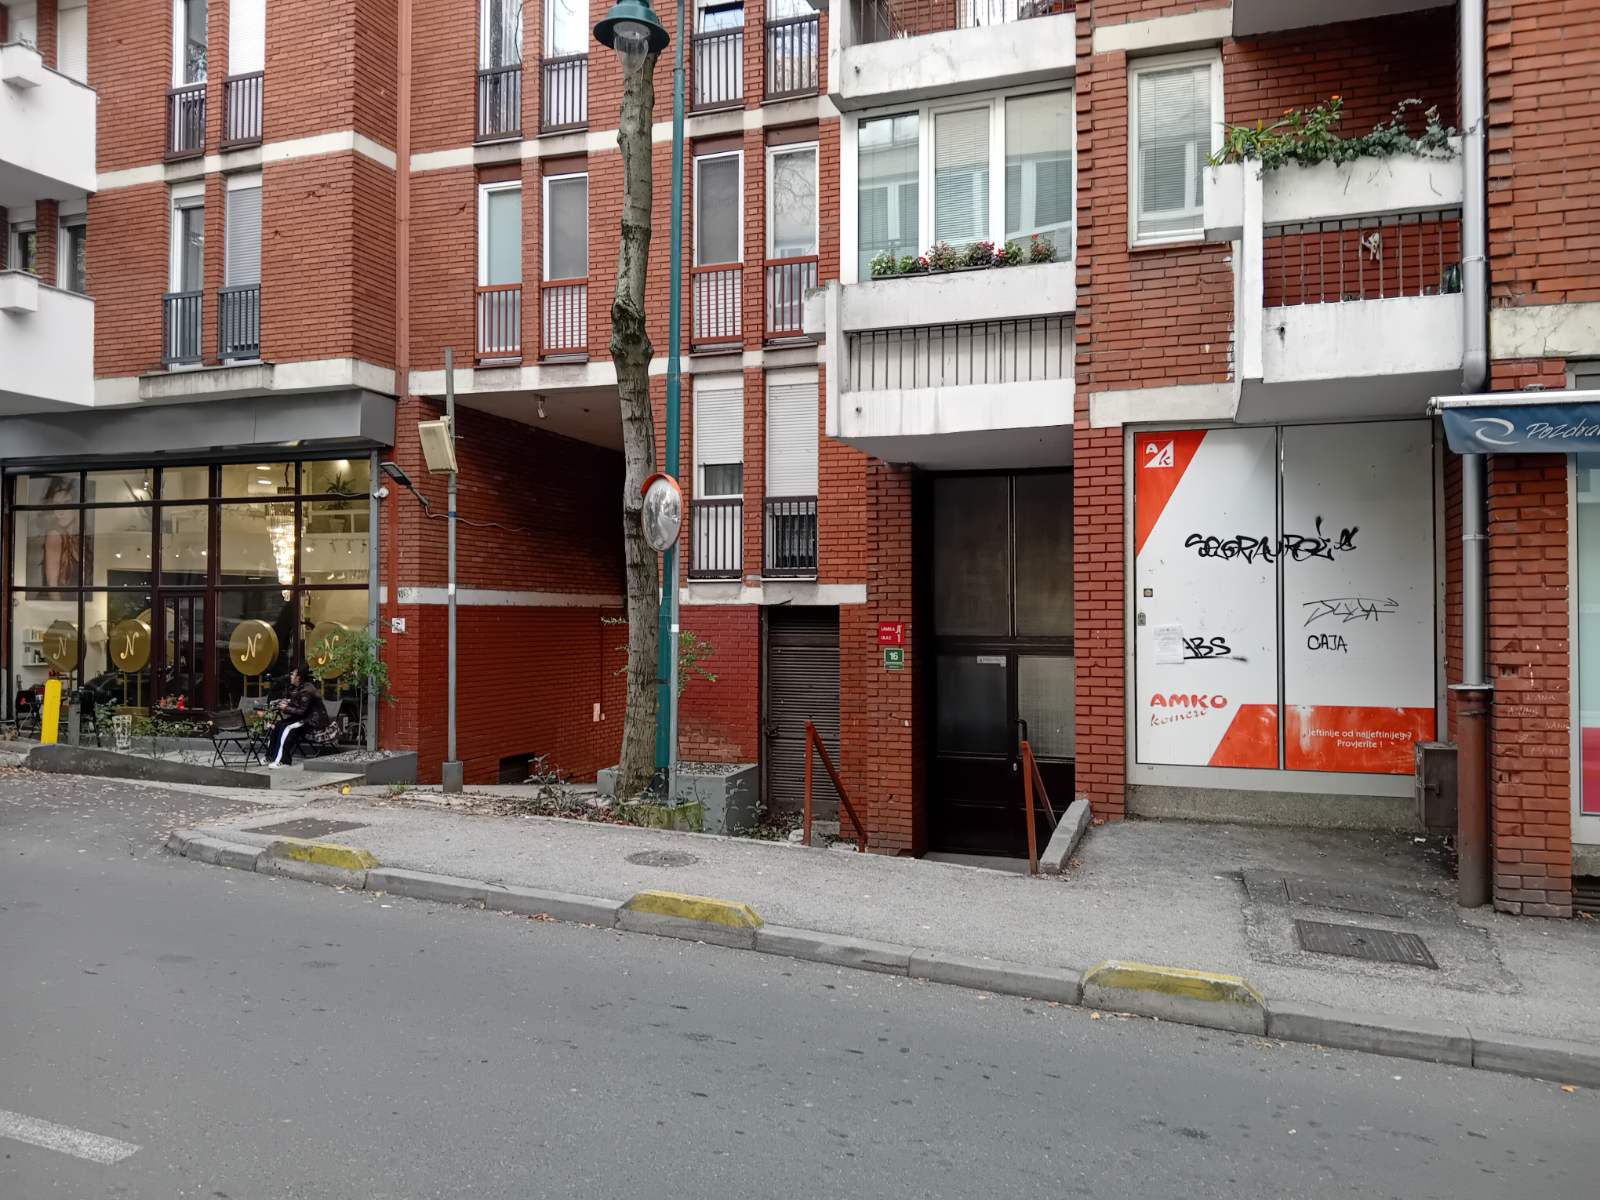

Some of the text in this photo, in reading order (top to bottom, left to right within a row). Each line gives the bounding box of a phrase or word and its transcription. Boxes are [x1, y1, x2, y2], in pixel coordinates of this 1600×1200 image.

[1526, 418, 1600, 439] Pozdra
[120, 631, 140, 659] N
[240, 632, 262, 661] N
[889, 651, 899, 660] 16
[1150, 692, 1228, 709] AMKO
